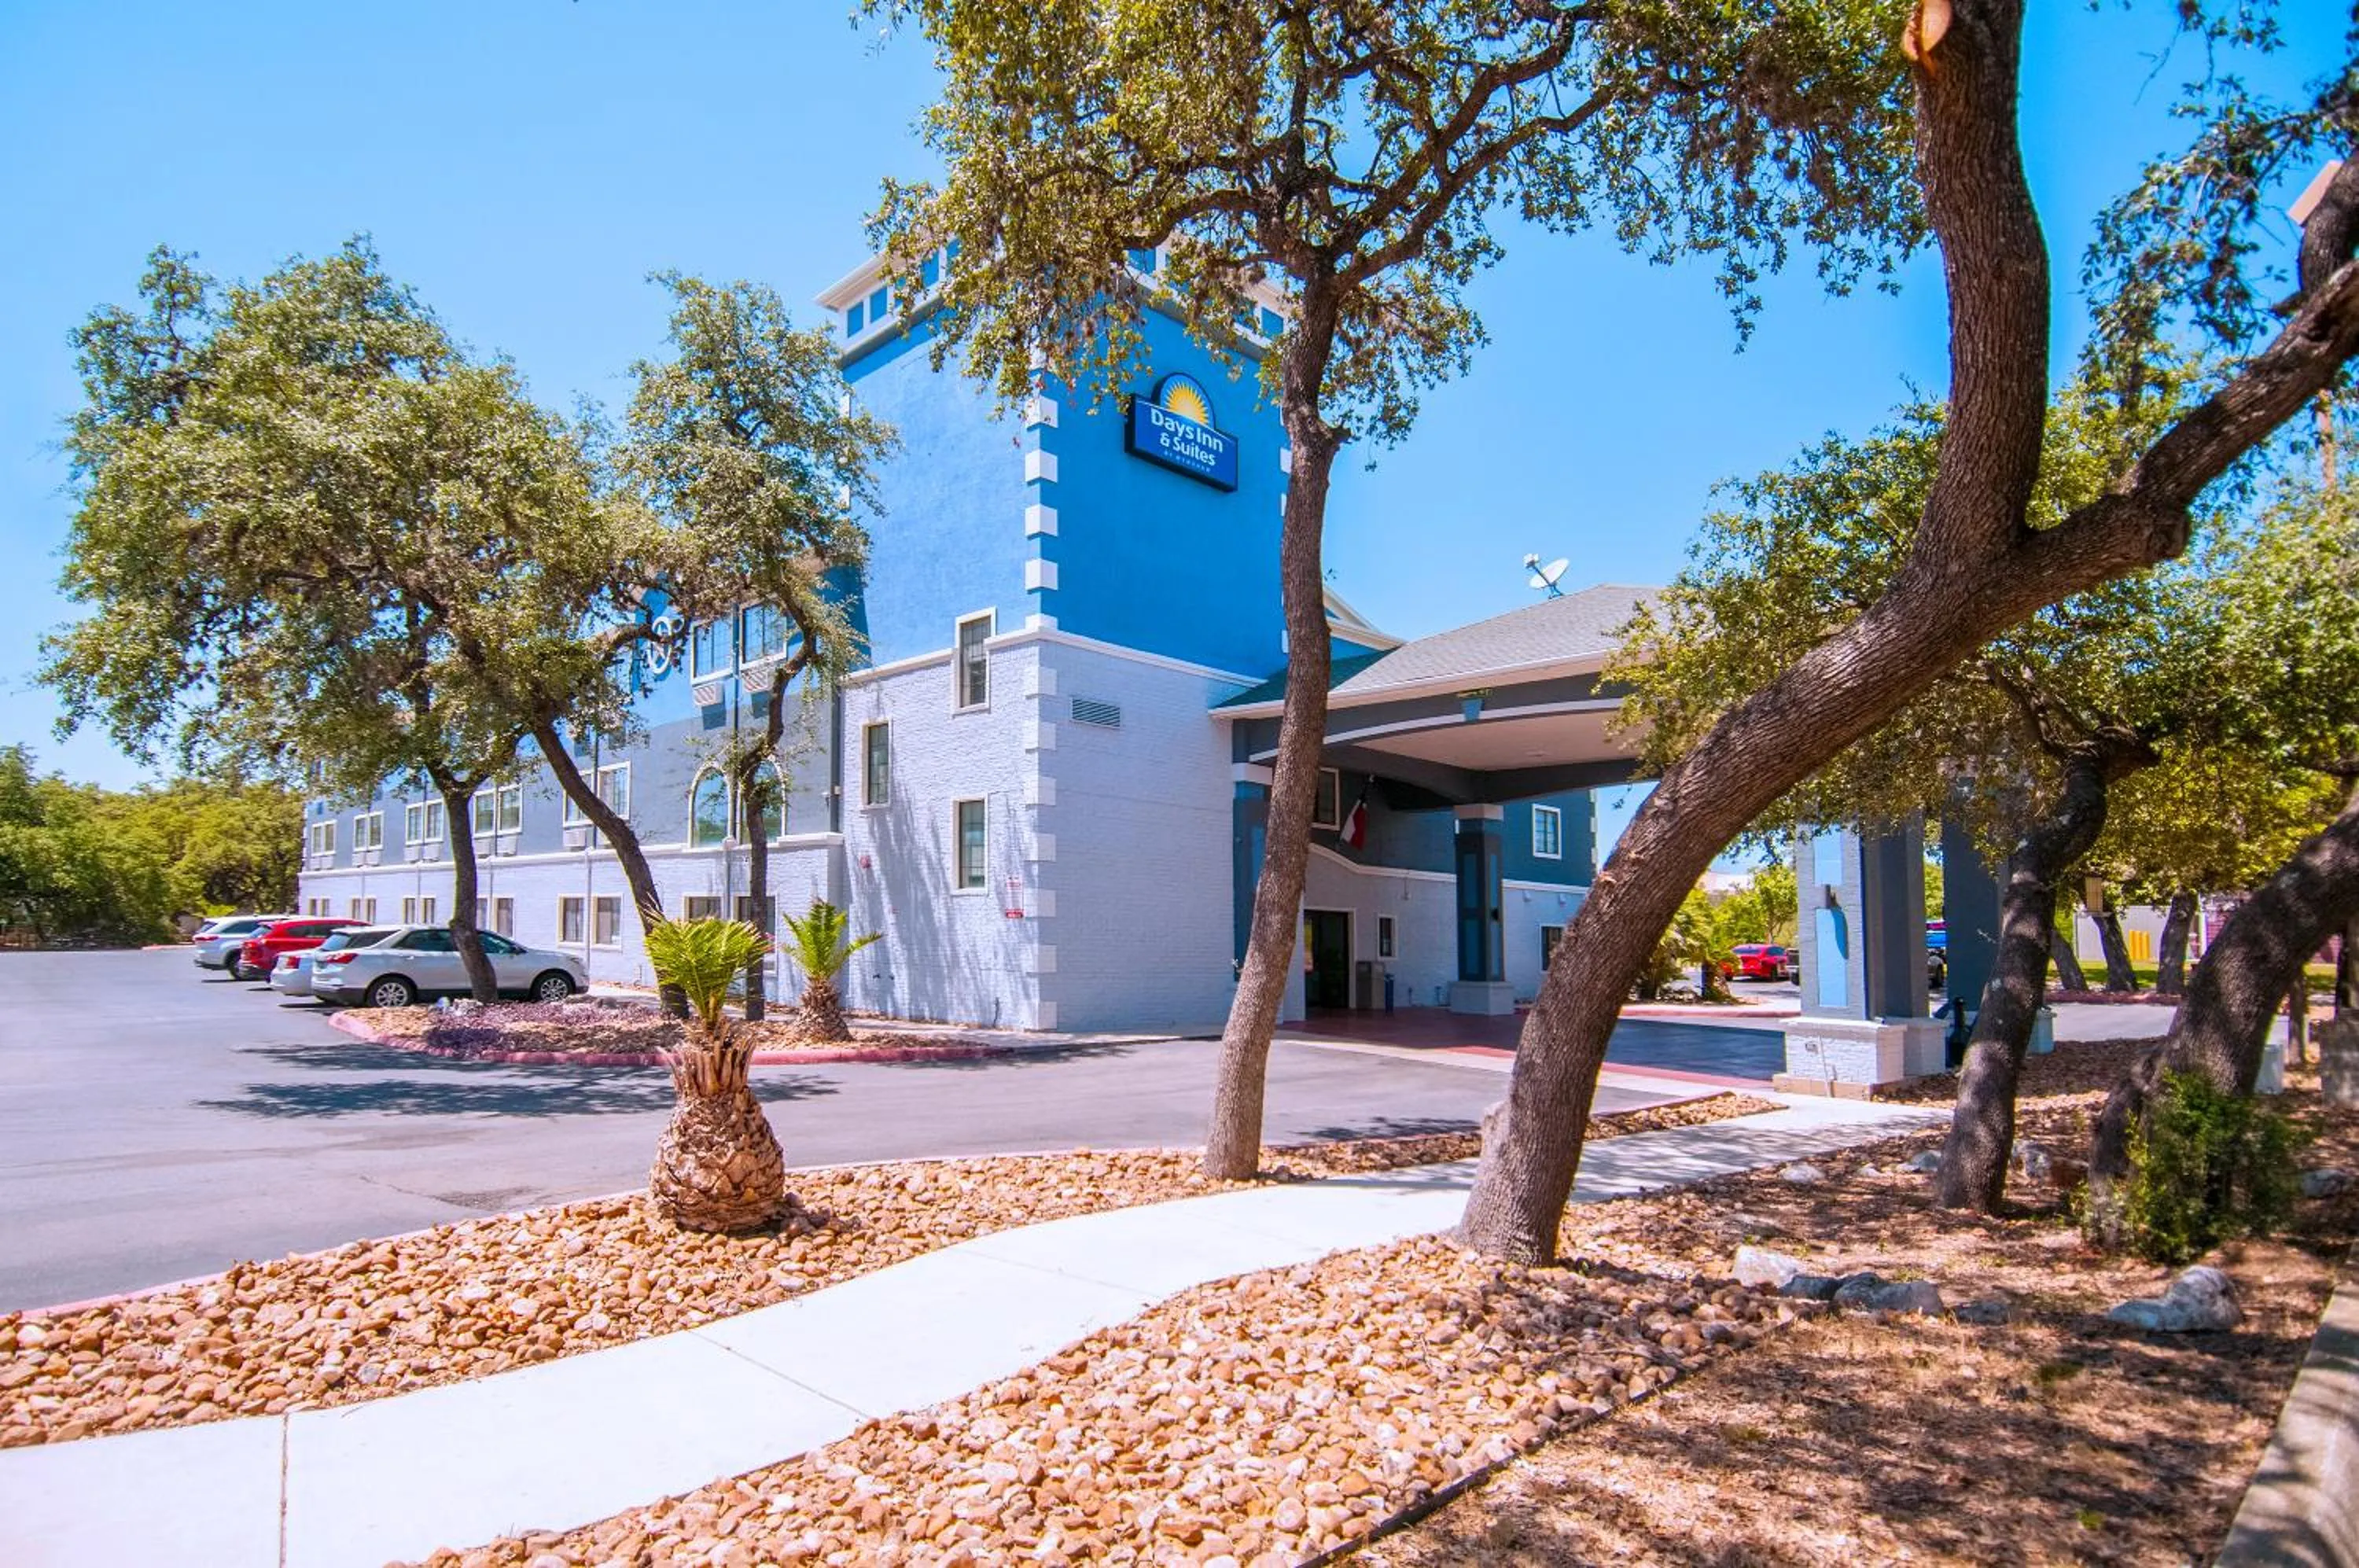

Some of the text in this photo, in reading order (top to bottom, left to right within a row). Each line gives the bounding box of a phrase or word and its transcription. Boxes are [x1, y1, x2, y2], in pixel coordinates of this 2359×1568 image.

[1150, 407, 1223, 453] Days Inn
[1160, 432, 1170, 447] &
[1173, 436, 1216, 466] Suites
